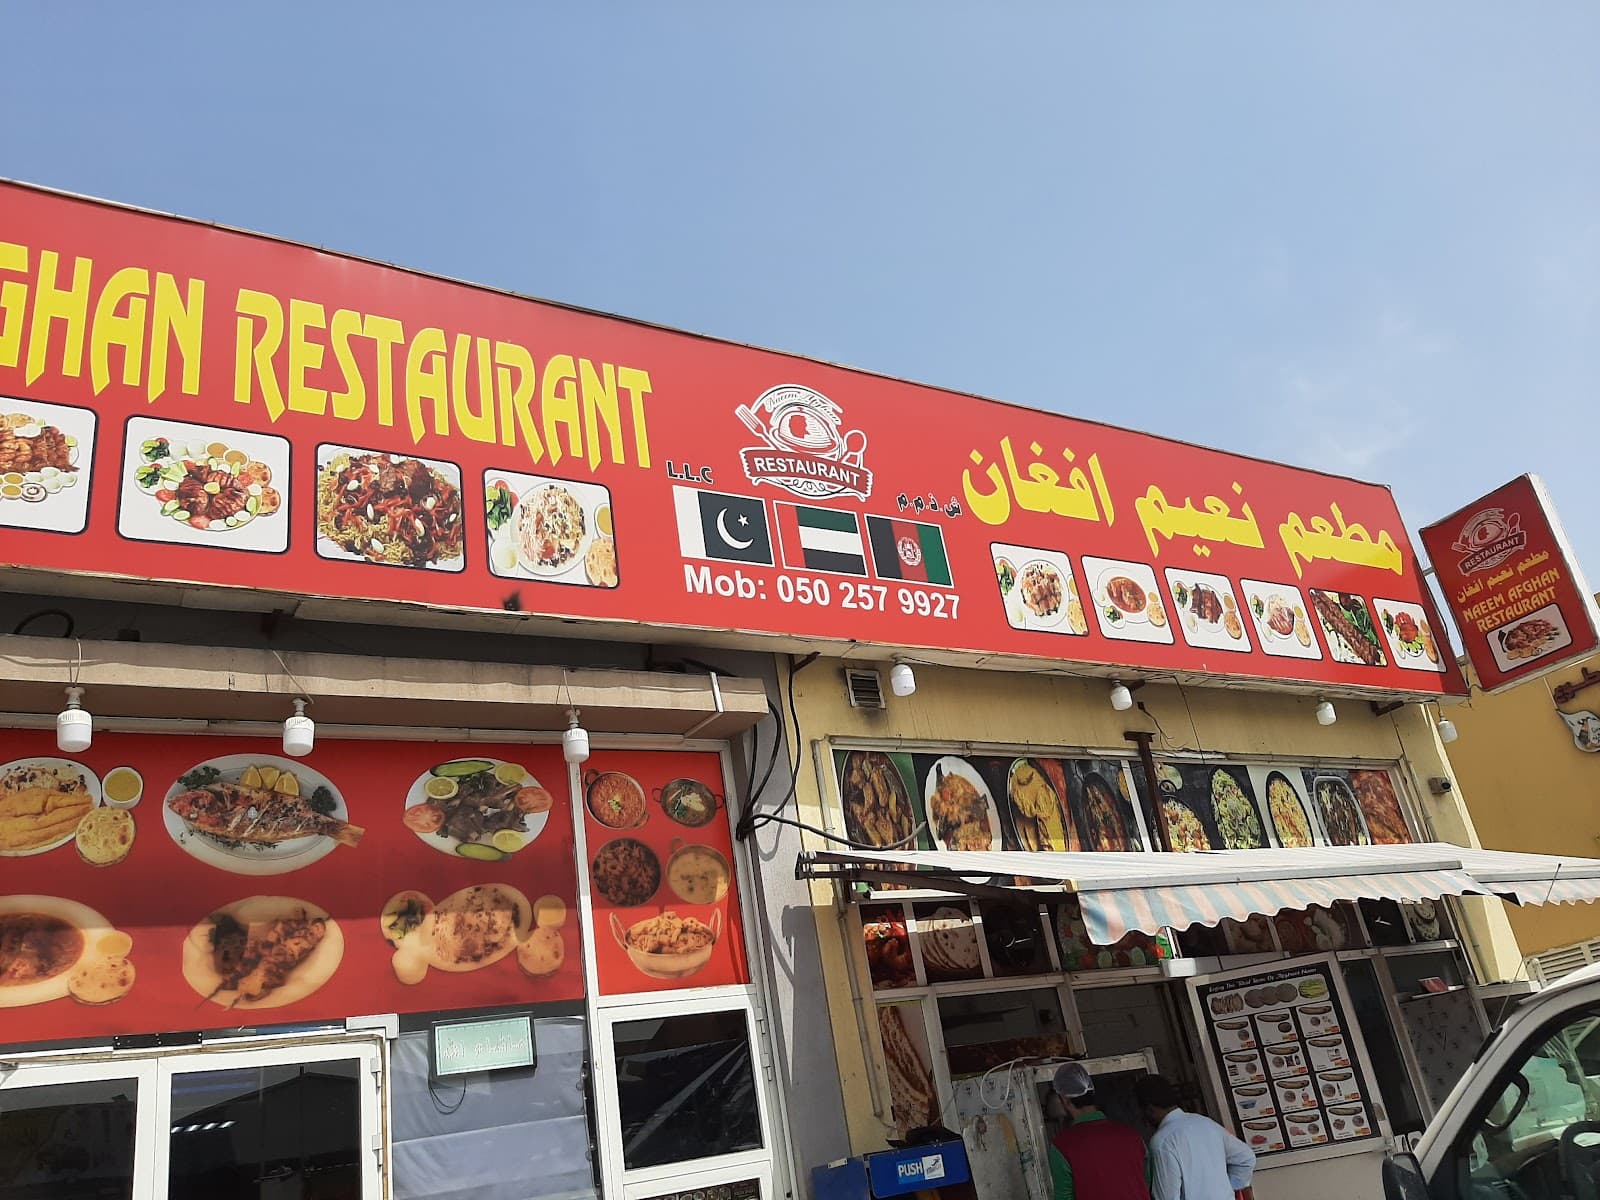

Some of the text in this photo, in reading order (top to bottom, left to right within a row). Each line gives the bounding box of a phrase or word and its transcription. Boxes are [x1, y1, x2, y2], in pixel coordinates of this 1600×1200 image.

[234, 288, 653, 472] RESTAURANT
[666, 460, 714, 485] L.L.C
[753, 457, 860, 487] RESTAURANT
[962, 435, 1115, 528] افغان
[1135, 481, 1265, 558] نعيم
[1279, 502, 1403, 580] مطعم
[1464, 536, 1520, 570] RESTAURANT
[1517, 550, 1550, 577] مطعم
[683, 563, 960, 620] Mob: 050 257 9927
[1462, 567, 1561, 623] NAEEM AFGHAN
[1487, 563, 1514, 591] نعيم
[1476, 586, 1556, 633] RESTAURANT
[898, 1161, 923, 1178] PUSH
